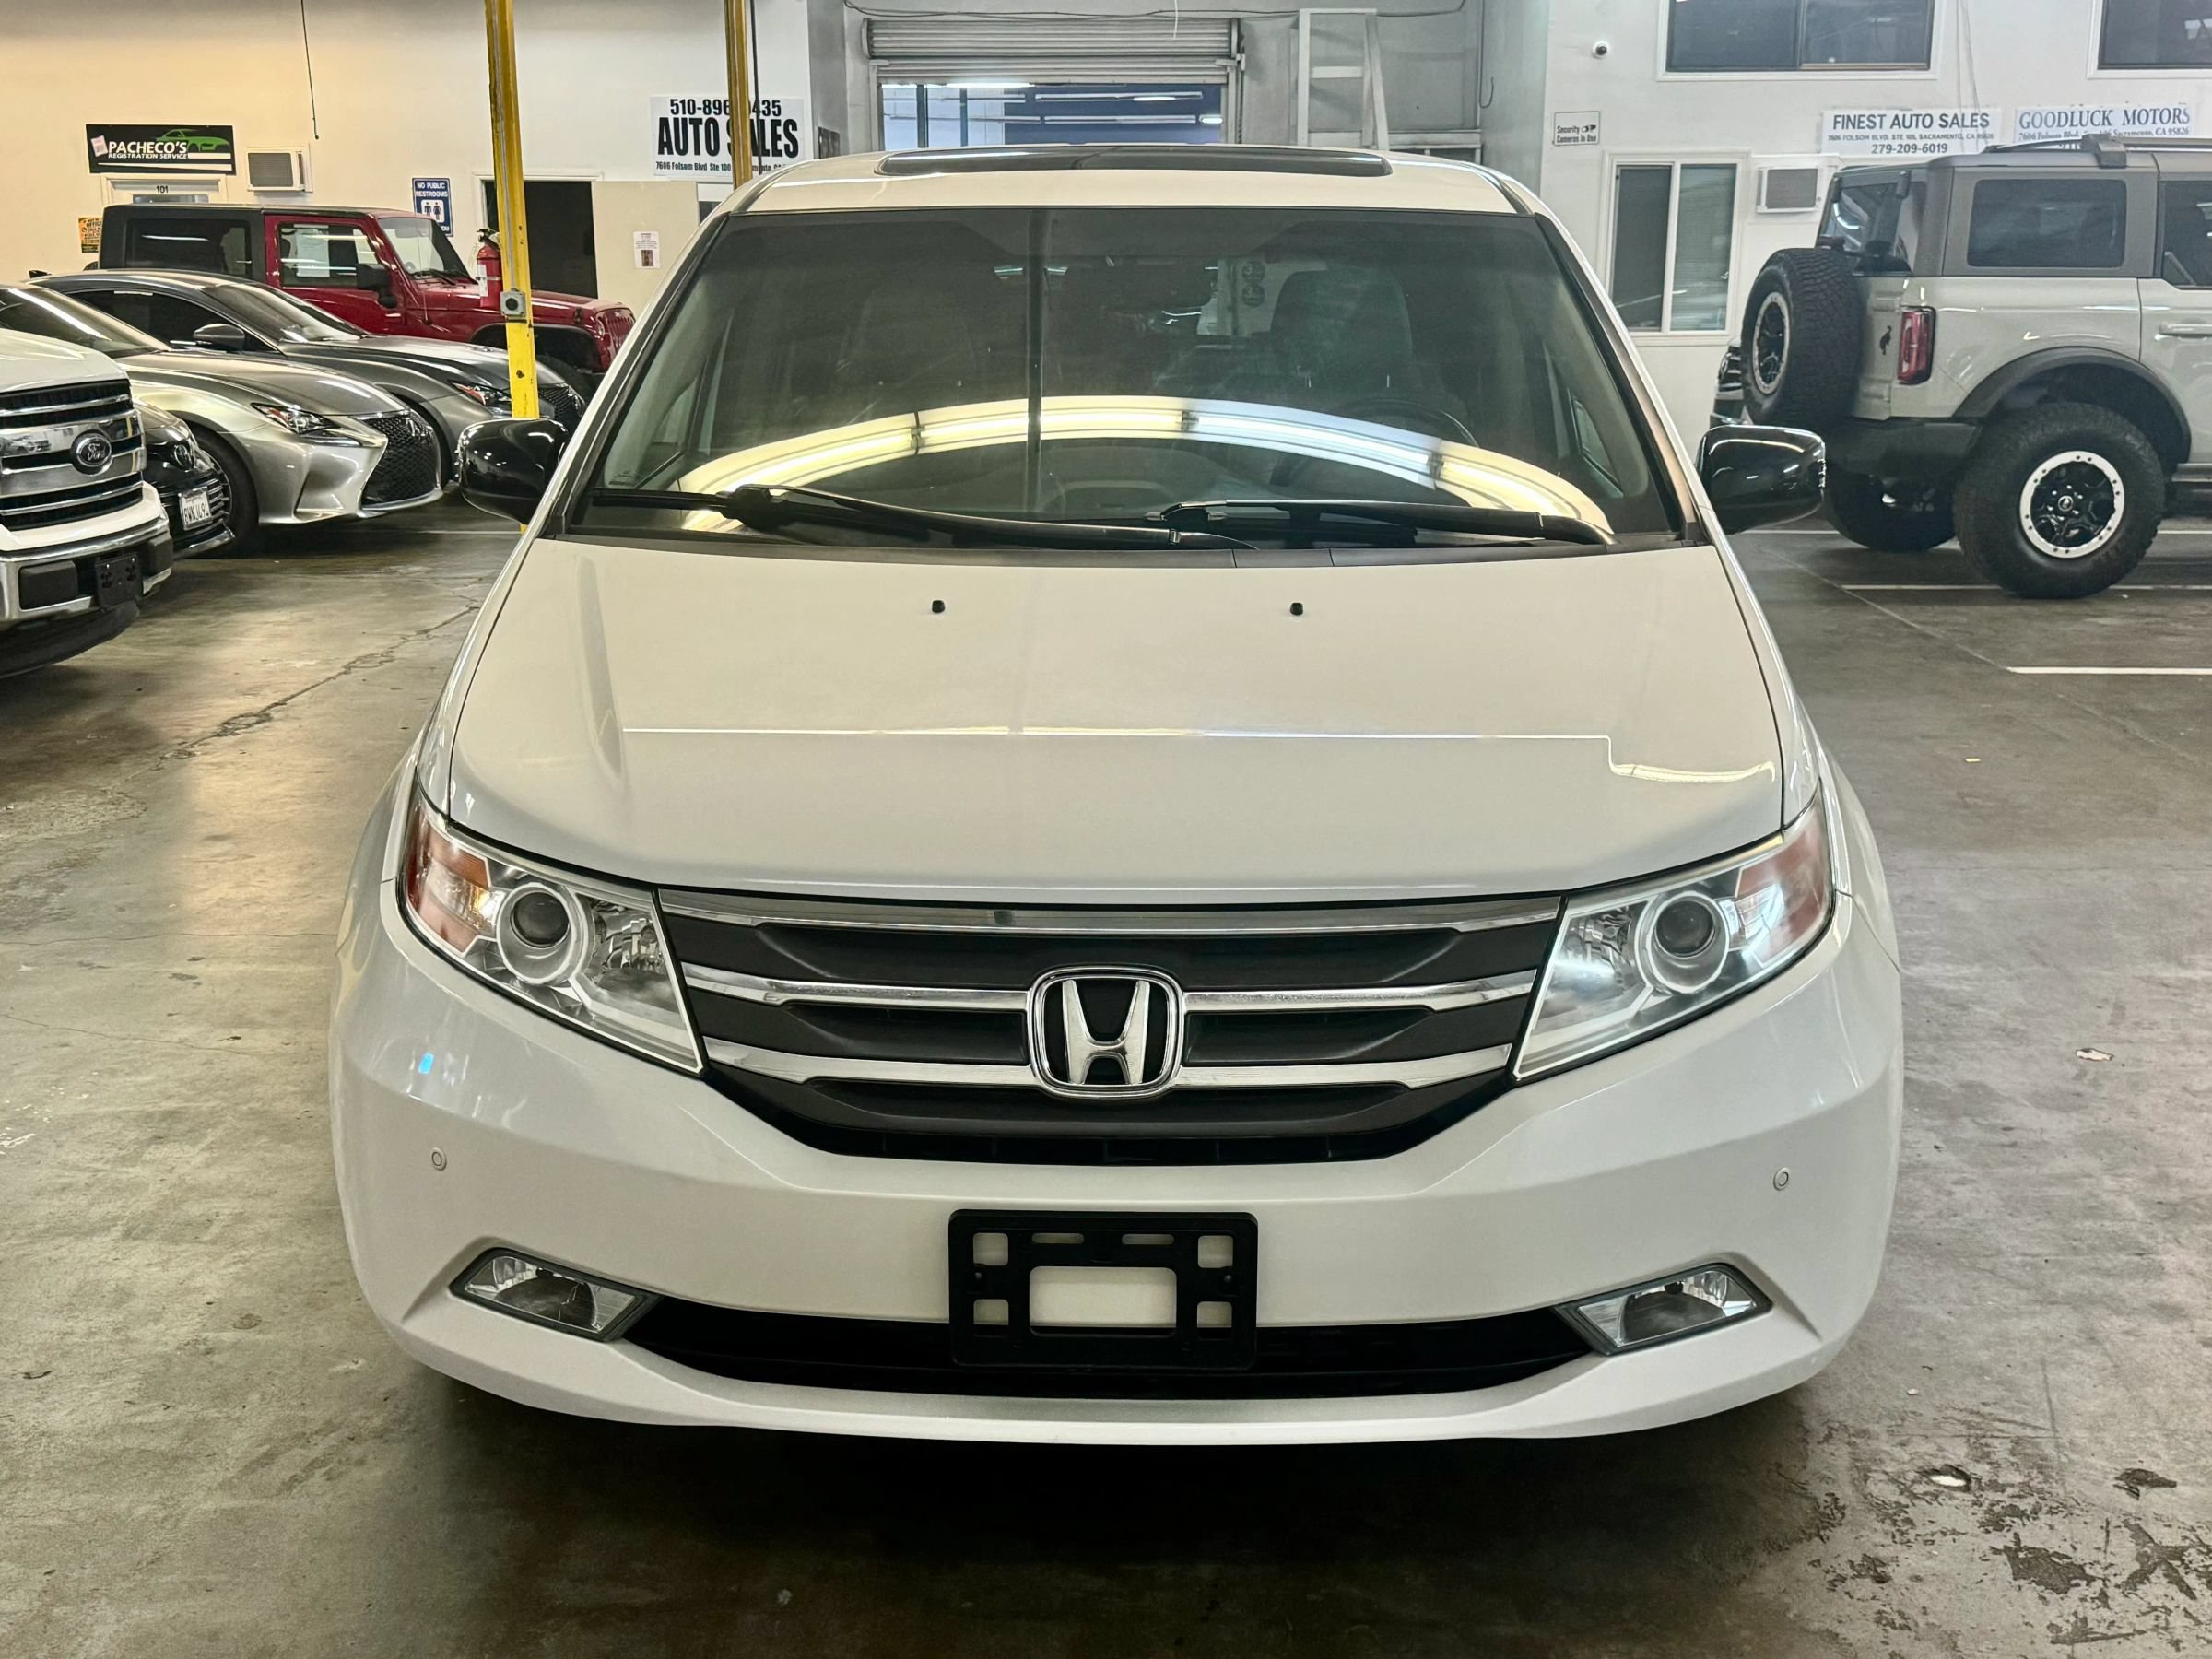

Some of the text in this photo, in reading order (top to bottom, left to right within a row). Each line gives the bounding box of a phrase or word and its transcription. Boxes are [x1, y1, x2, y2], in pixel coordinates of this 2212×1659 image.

[1833, 112, 1990, 130] FINEST AUTO SALES
[2018, 107, 2191, 129] GOODLUCK MOTORS
[1557, 125, 1580, 135] Security
[2155, 127, 2167, 136] CA
[657, 117, 799, 159] AUTO ALES
[1557, 135, 1580, 143] Cameras
[108, 141, 187, 154] PACHECO'S
[1871, 142, 1948, 155] 279-209-6019
[655, 160, 671, 171] 7606
[709, 162, 719, 171] Ste
[156, 185, 169, 194] 101
